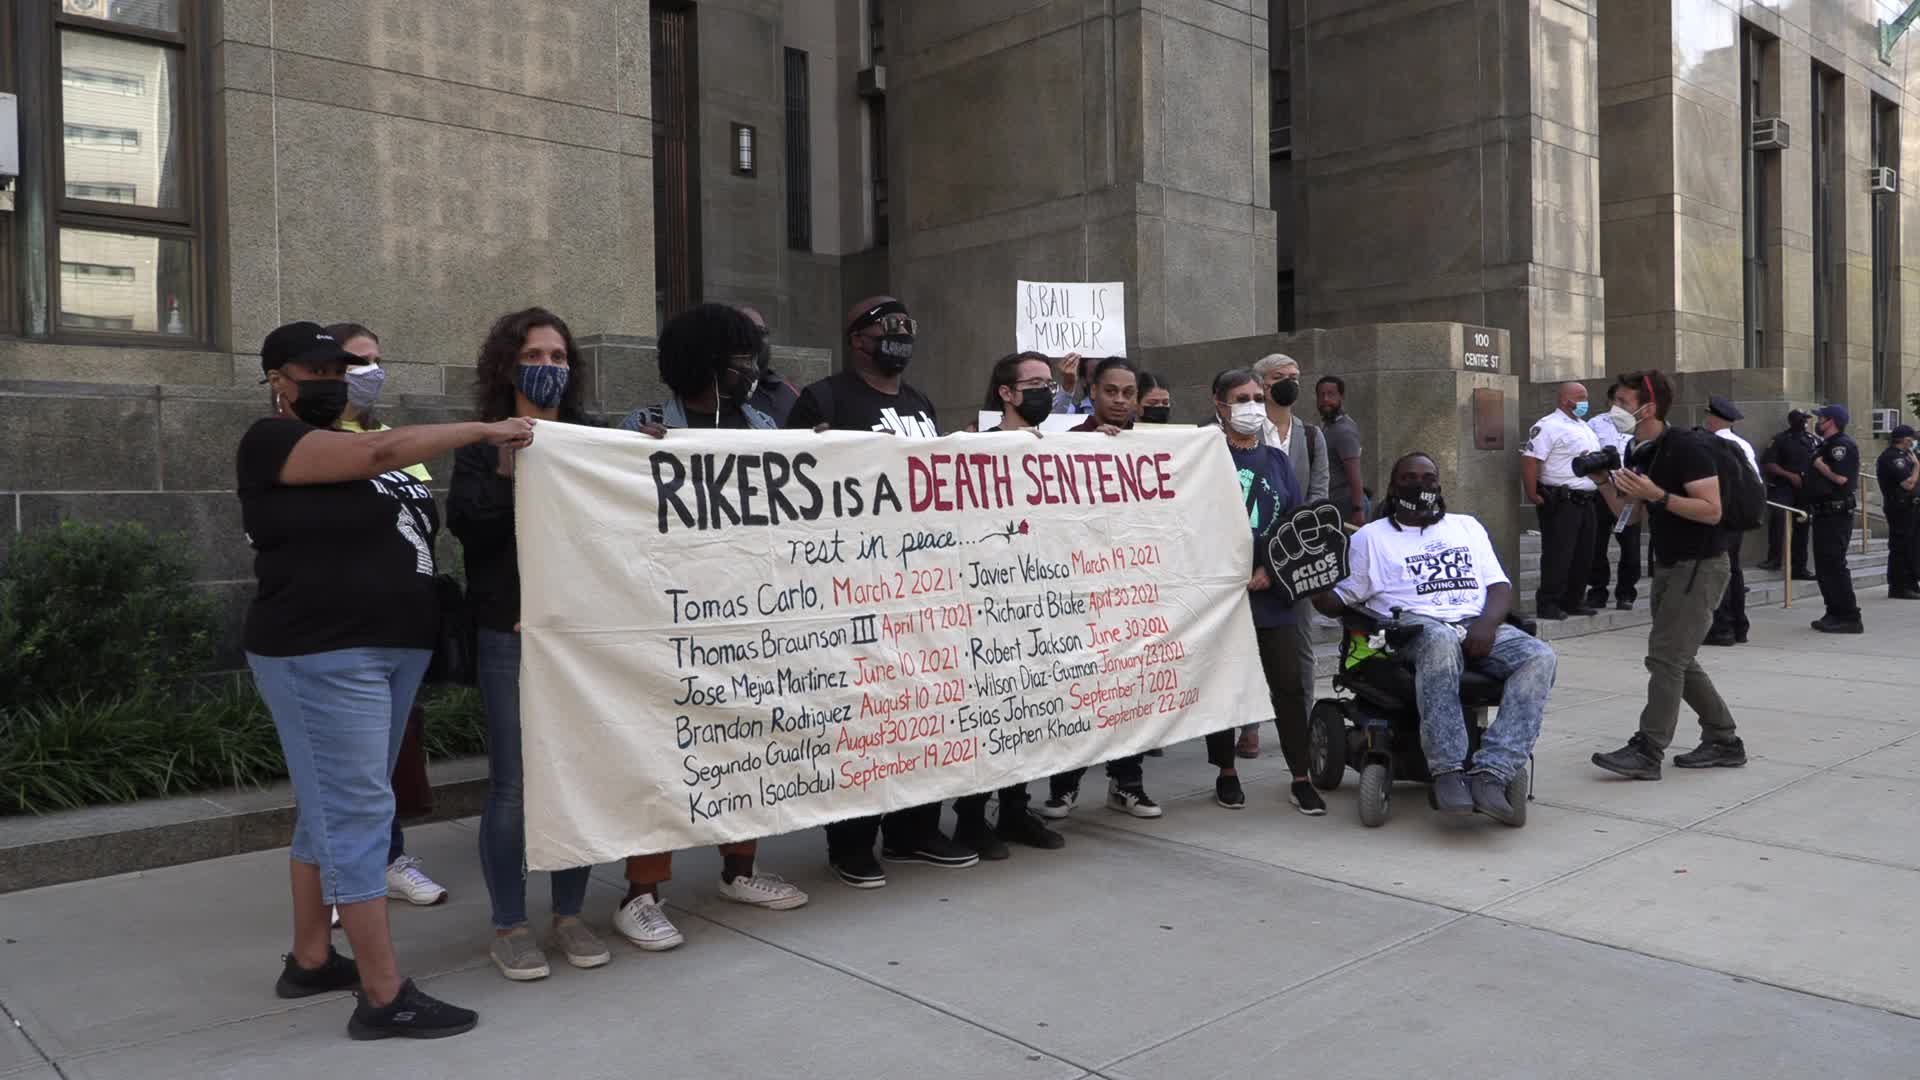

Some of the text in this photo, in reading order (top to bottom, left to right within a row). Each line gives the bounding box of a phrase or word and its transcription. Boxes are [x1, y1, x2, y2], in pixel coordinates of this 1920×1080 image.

[1026, 284, 1108, 324] $BAIL IS
[1035, 321, 1104, 351] MURDER
[1474, 334, 1489, 347] 100
[1465, 352, 1499, 368] CENTRE ST
[649, 450, 1175, 534] RIKERS IS A DEATH SENTENCE
[787, 529, 845, 564] rest
[856, 531, 888, 560] in
[1410, 551, 1472, 576] VOCAL
[664, 545, 1160, 623] Tomas Carlo, March 2 2021 Javier Velasco March 19 2021
[1418, 581, 1455, 592] SAVING
[1428, 564, 1462, 581] 20
[669, 584, 1159, 668] Thomas Braunson III April 19 2021 Richard Blake April 30 2021
[674, 616, 1169, 705] Jose Mejia Martinez June 10 2021 Robert Jackson June 30 2021
[676, 640, 1184, 749] Brandon Rodriguez August 10 2021 Wilson Diaz-Guzman January 23 2021
[683, 669, 1177, 789] Segundo Guallpa August 30 2021 Esias Johnson September 7 2021
[689, 687, 1199, 824] Karim Isaabdul September 19 2021 Stephen Khadu September 22 2021
